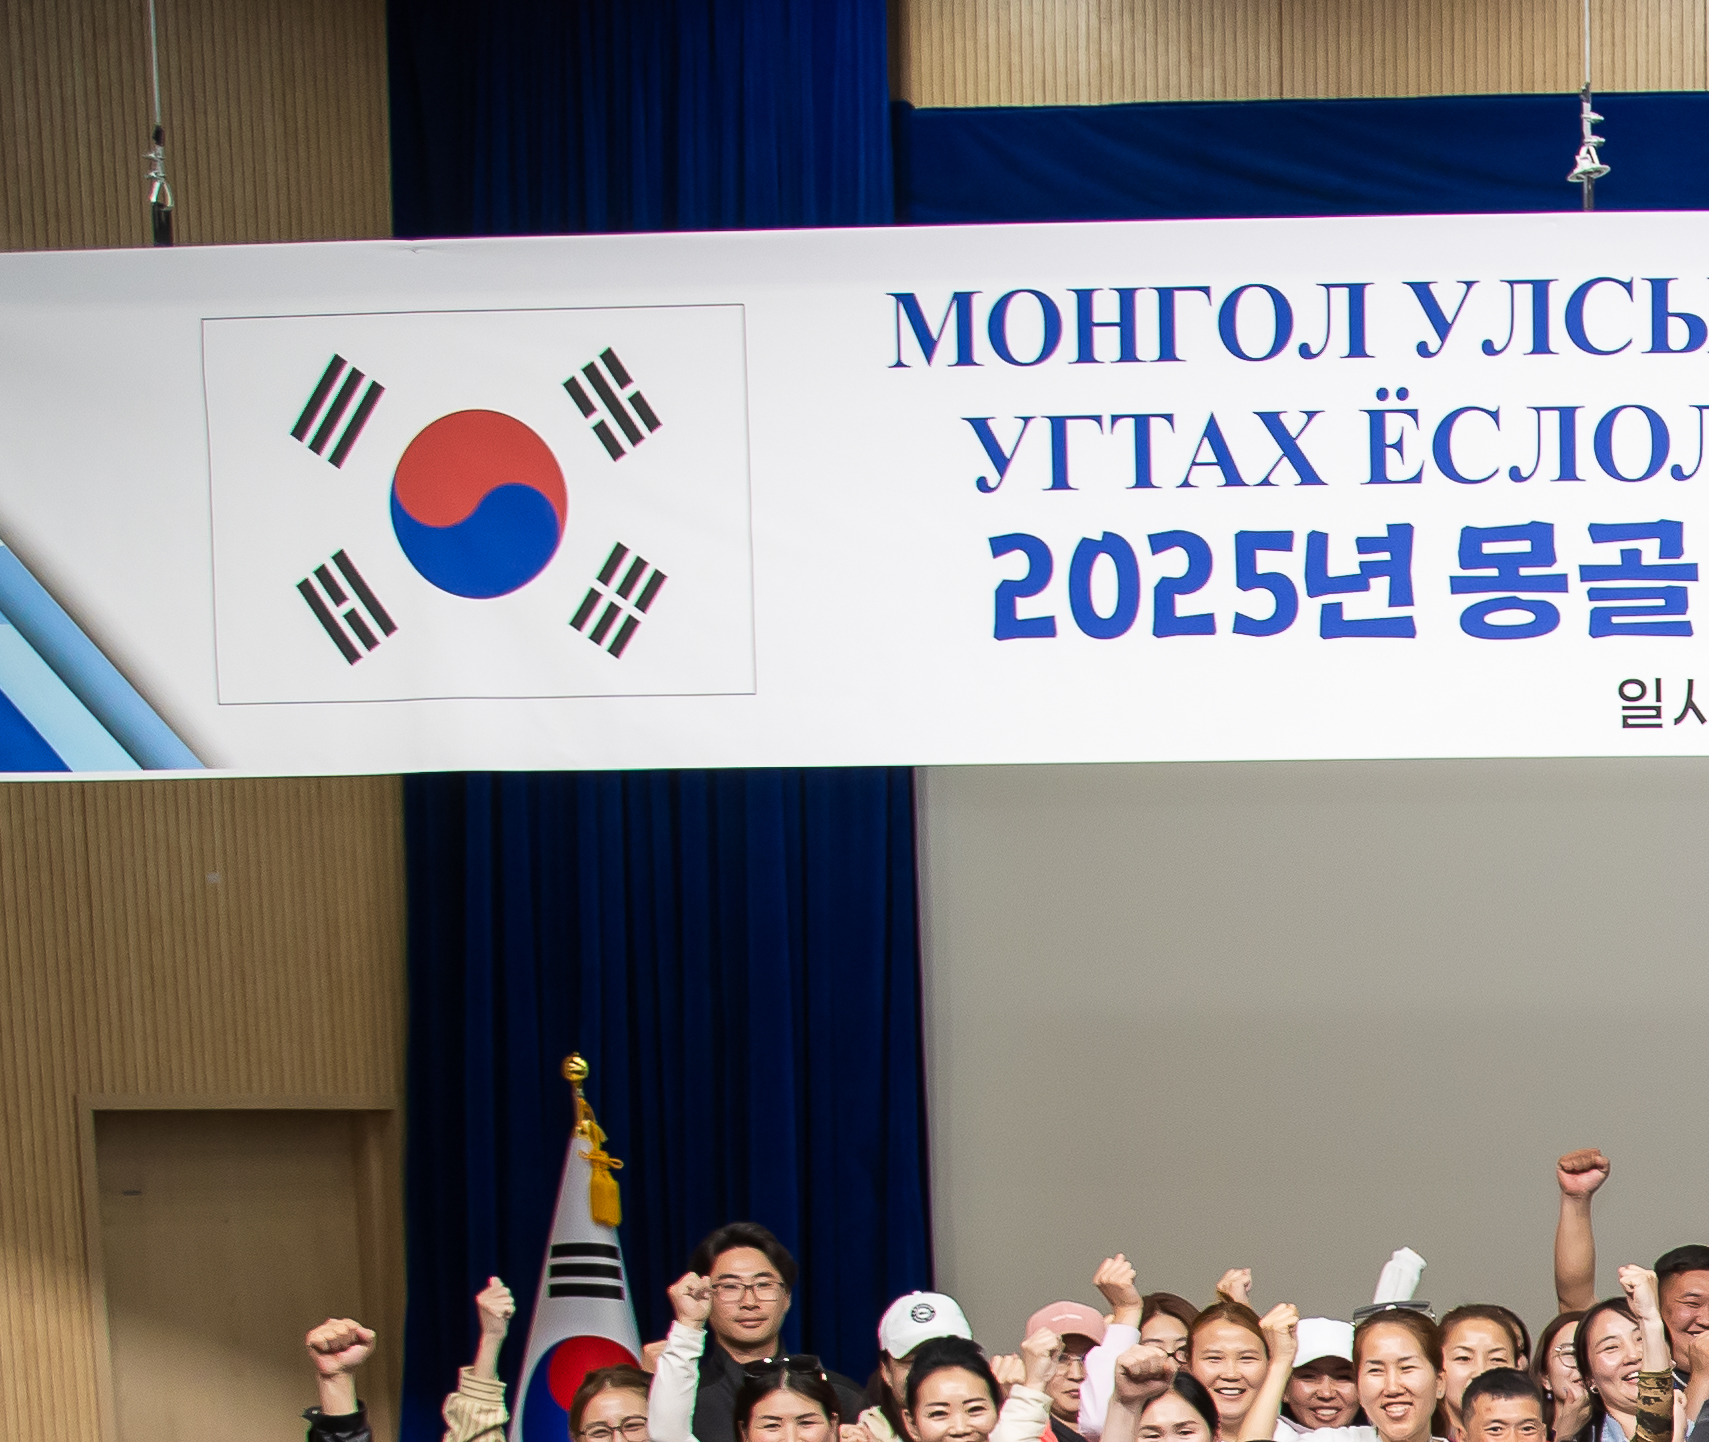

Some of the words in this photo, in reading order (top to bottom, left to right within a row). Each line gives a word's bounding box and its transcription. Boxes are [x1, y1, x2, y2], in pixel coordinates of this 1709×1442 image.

[886, 283, 1374, 368] МОНГОЛ
[962, 411, 1328, 493] УГТАХ
[988, 523, 1416, 640] 2025년
[1449, 519, 1698, 639] 몽골
